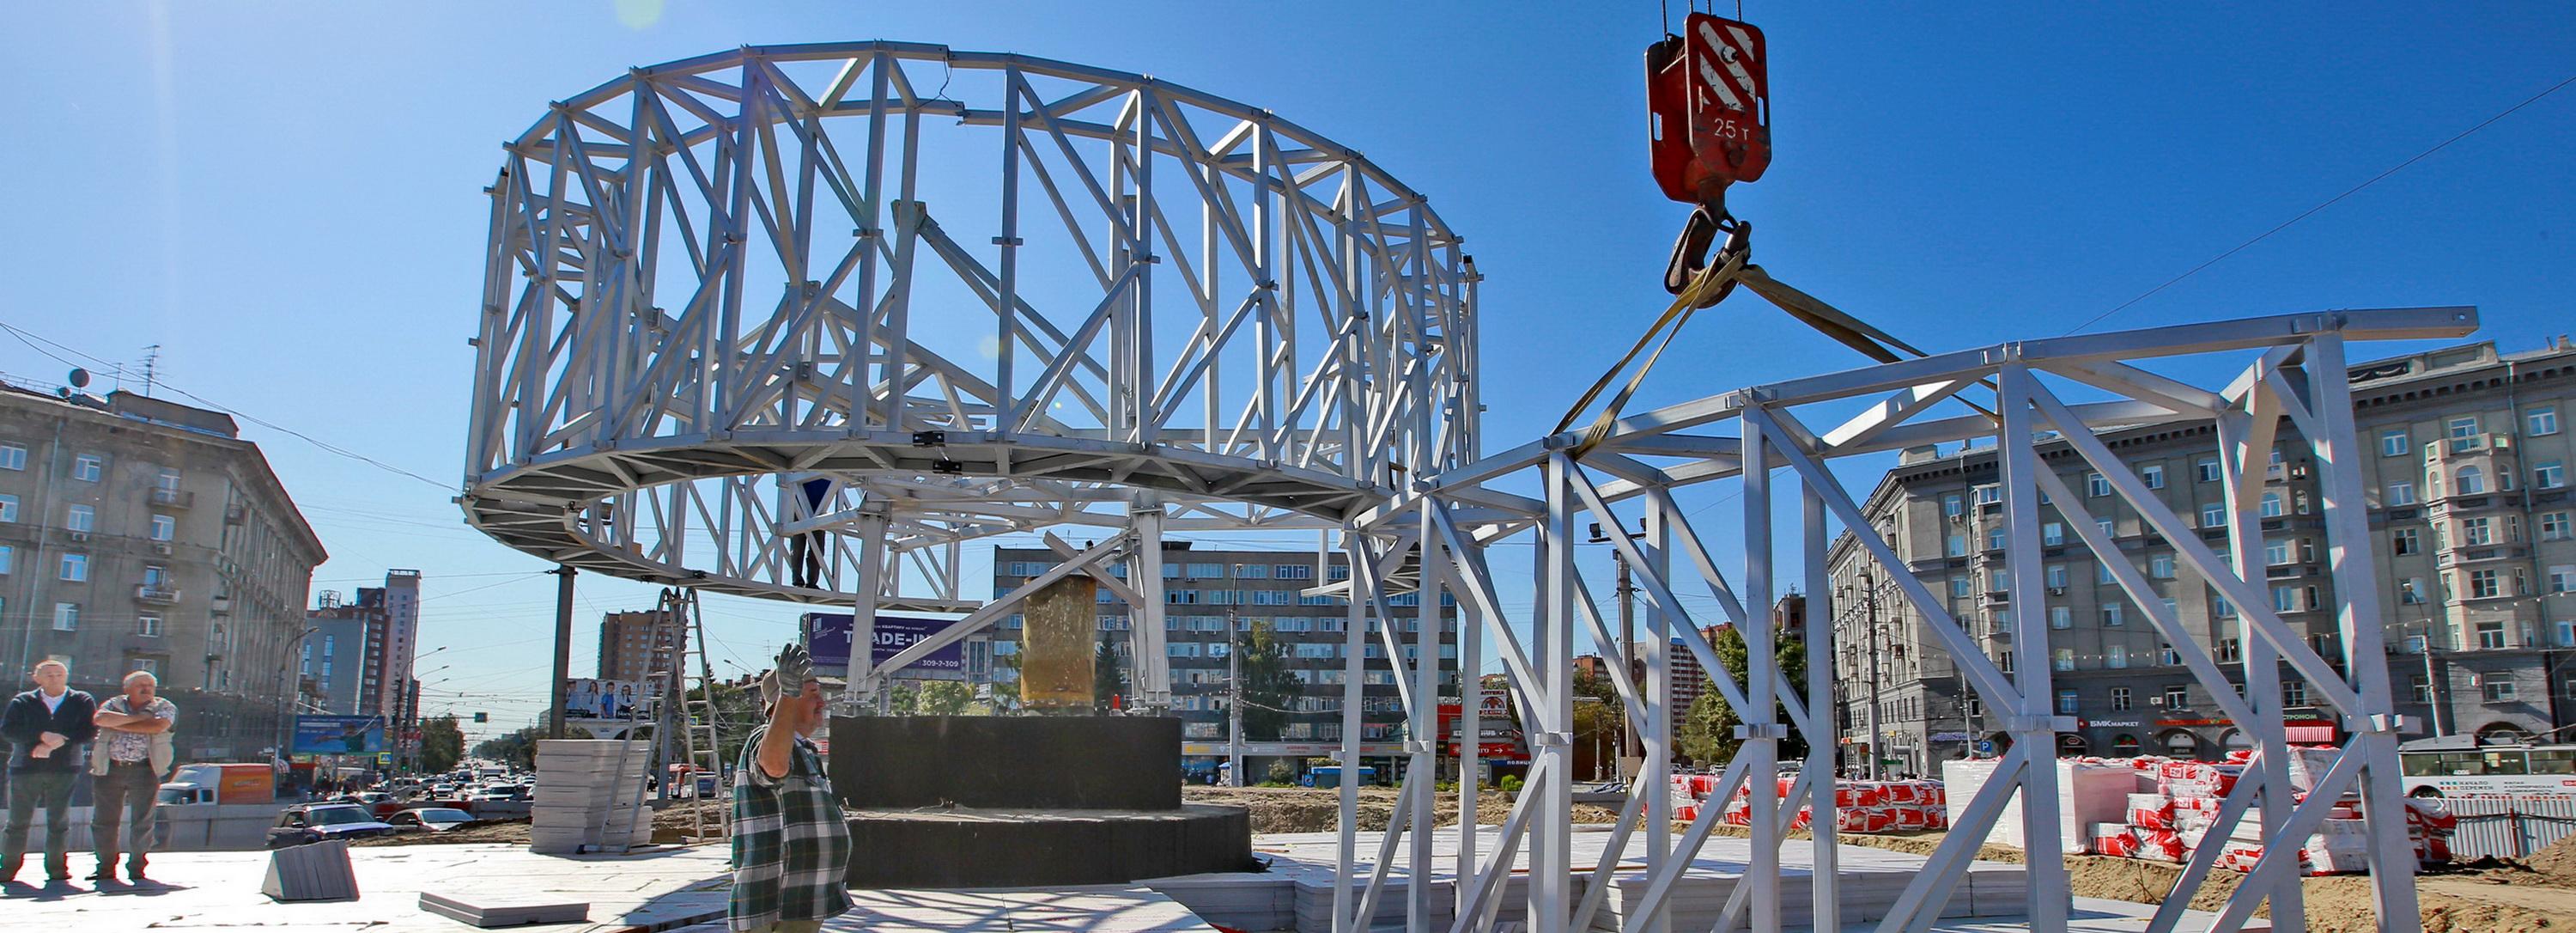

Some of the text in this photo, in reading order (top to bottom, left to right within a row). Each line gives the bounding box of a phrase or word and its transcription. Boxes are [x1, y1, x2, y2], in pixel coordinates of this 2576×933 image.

[1714, 118, 1736, 138] 25
[843, 629, 931, 646] TADE-IN
[1982, 742, 1990, 751] P
